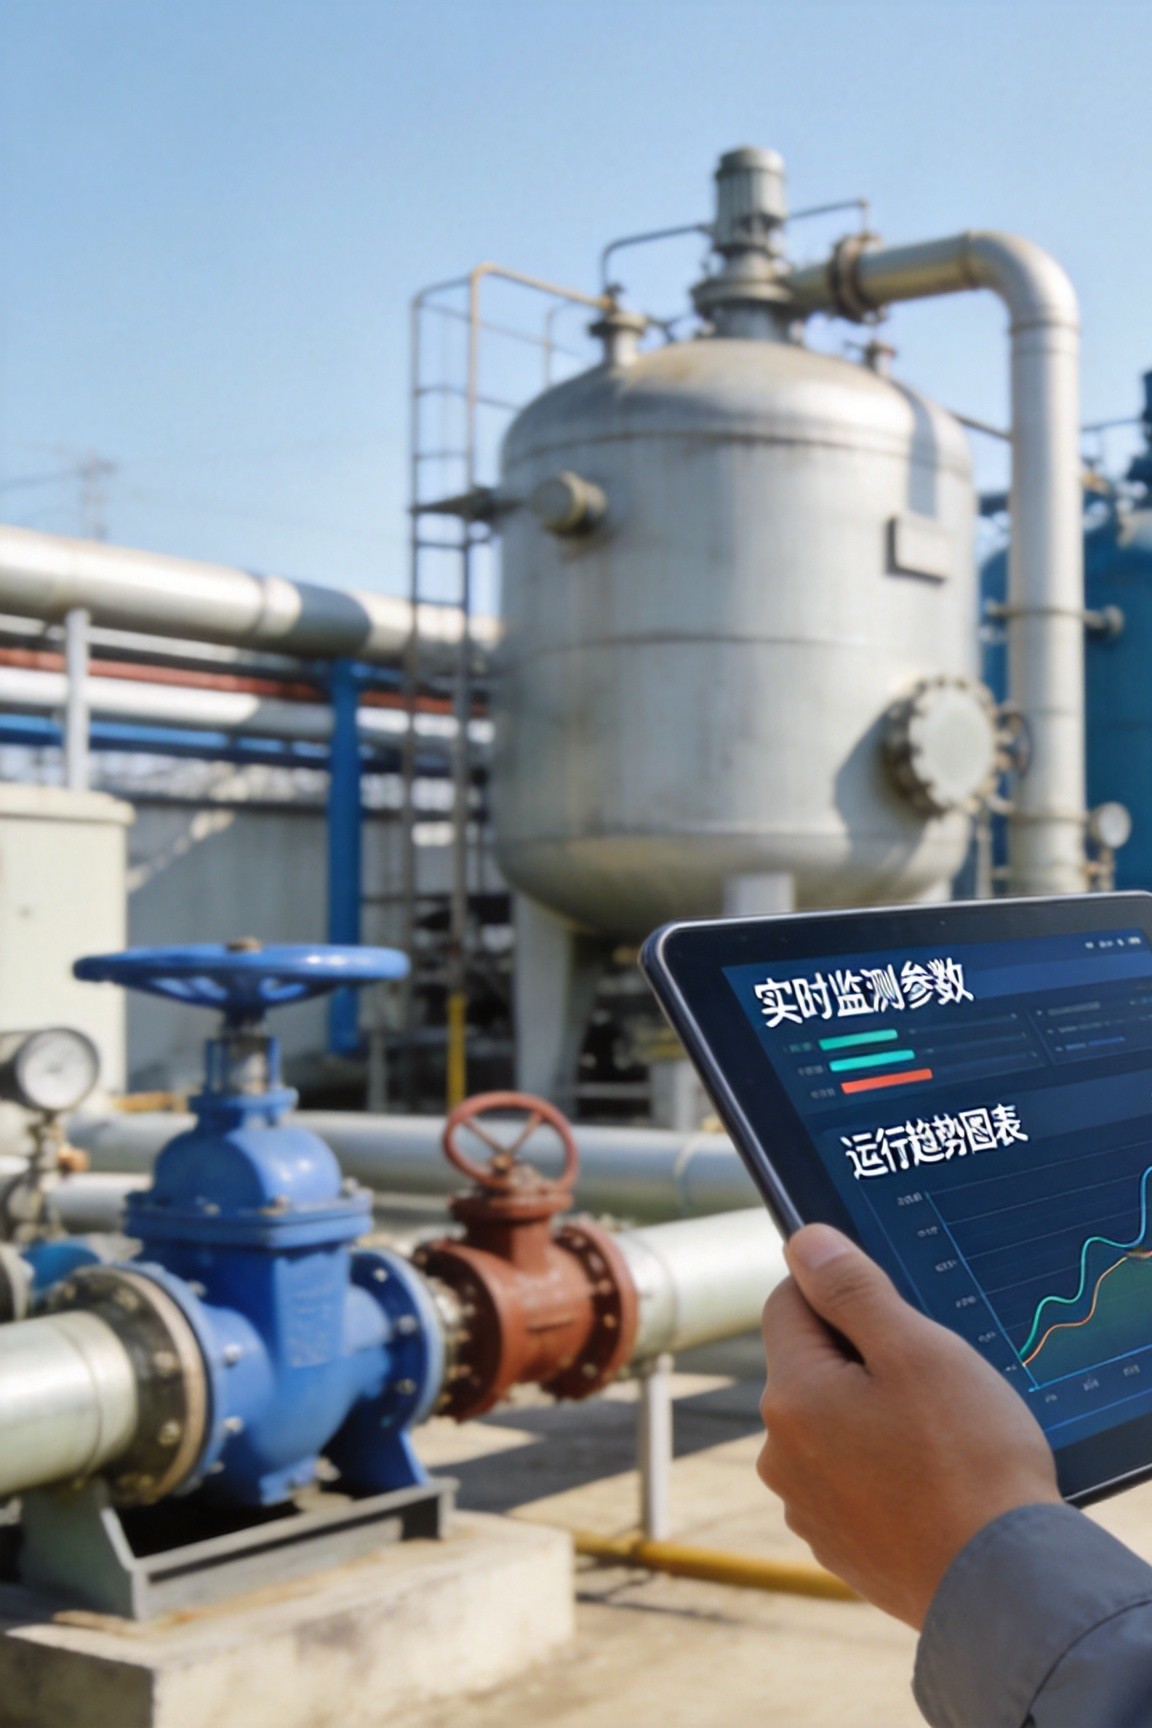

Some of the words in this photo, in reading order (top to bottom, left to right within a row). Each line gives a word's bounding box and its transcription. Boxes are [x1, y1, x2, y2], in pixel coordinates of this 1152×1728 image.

[754, 957, 974, 1028] 实时监测参数
[839, 1104, 1029, 1179] 运行趋势图表
